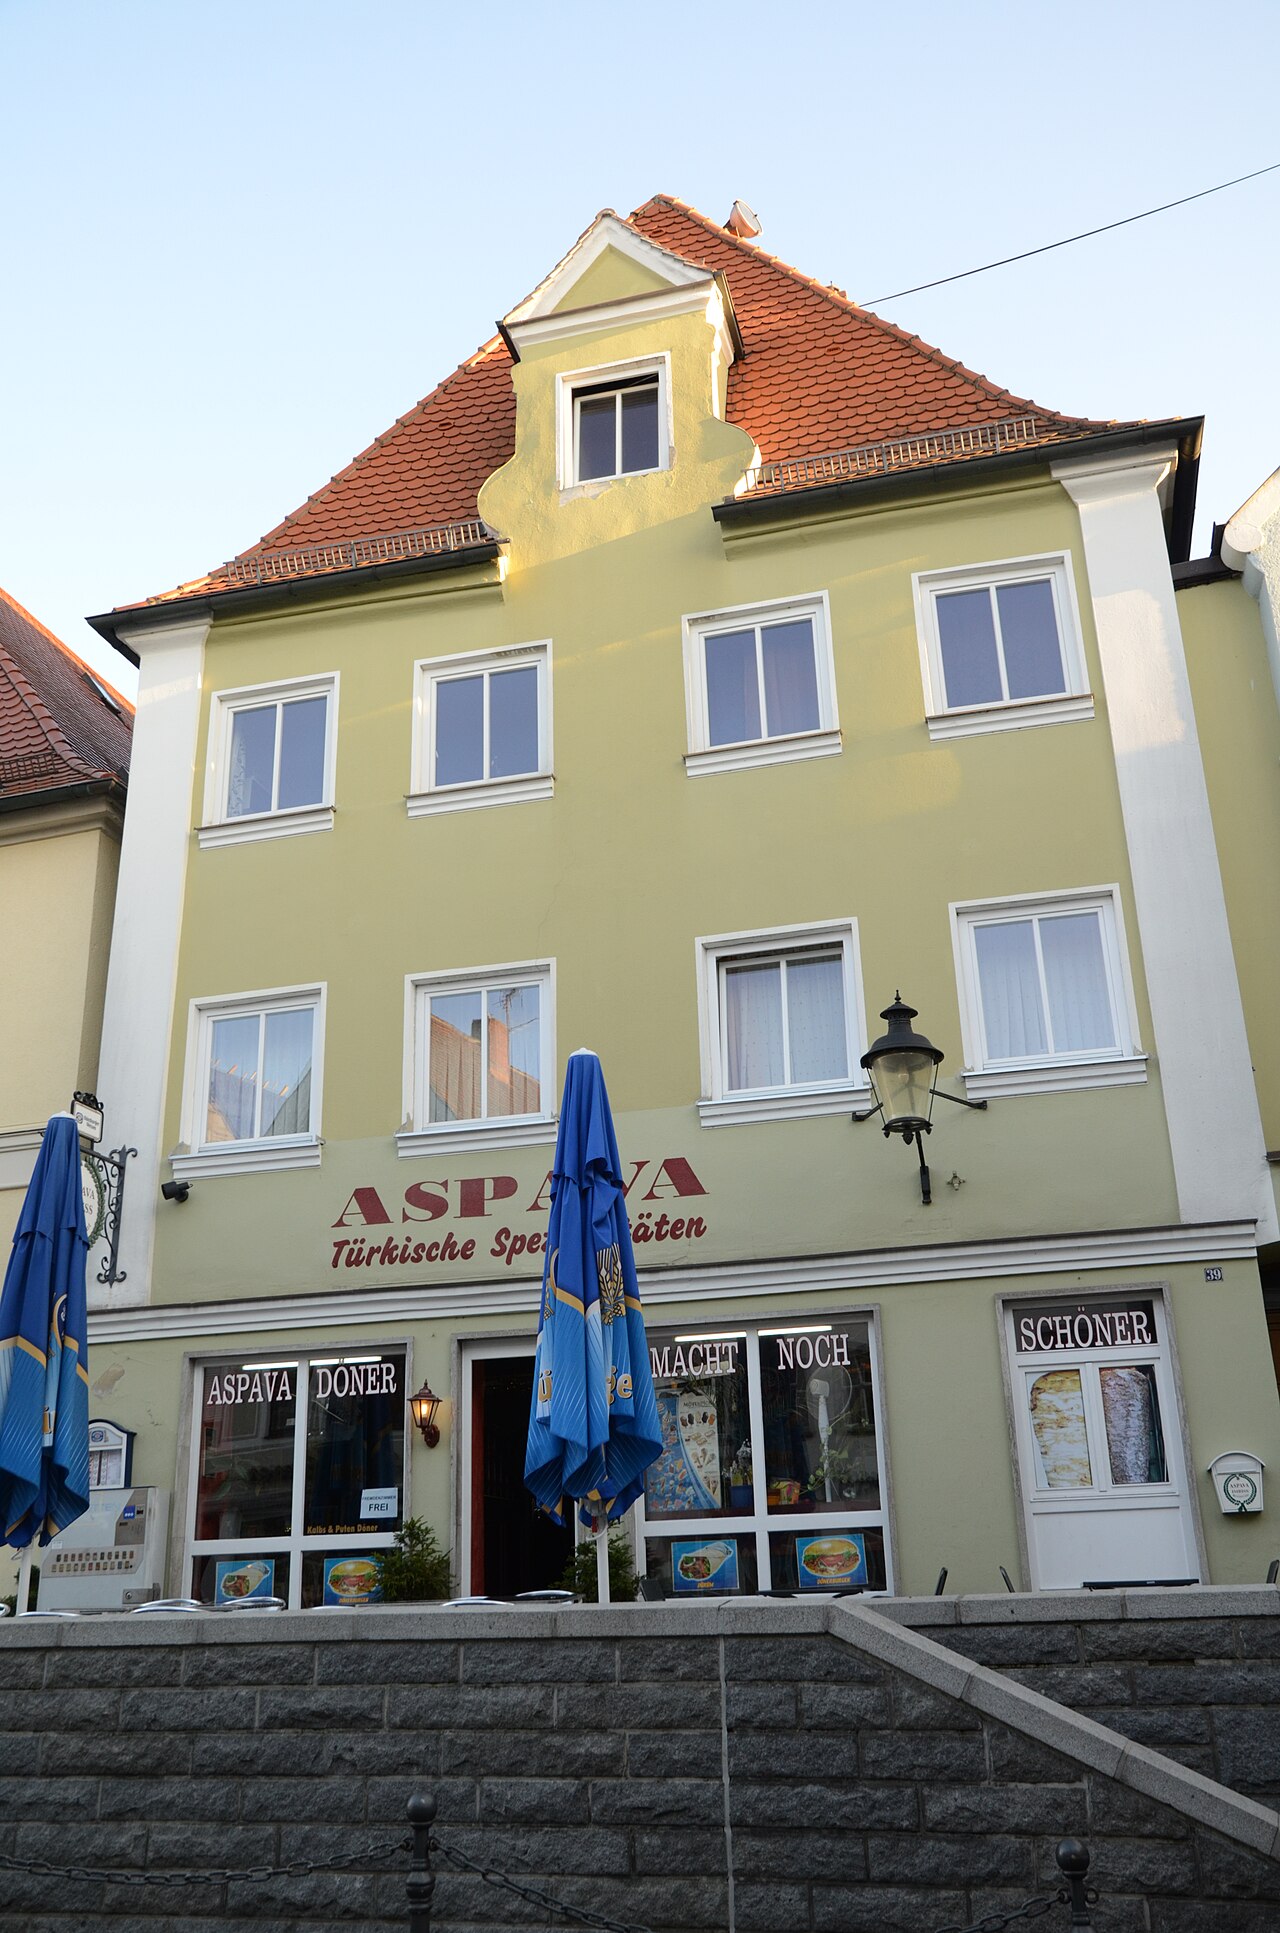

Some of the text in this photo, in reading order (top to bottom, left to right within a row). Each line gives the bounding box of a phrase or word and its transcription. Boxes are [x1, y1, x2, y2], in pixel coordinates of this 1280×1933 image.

[331, 1212, 707, 1269] Türkische Speäten
[1206, 1269, 1222, 1281] 39
[1020, 1306, 1152, 1351] SCHÖNER
[650, 1333, 851, 1379] MACHT NOCH
[206, 1370, 293, 1405] ASPAVA
[368, 1503, 389, 1512] FREI
[328, 1525, 334, 1533] &
